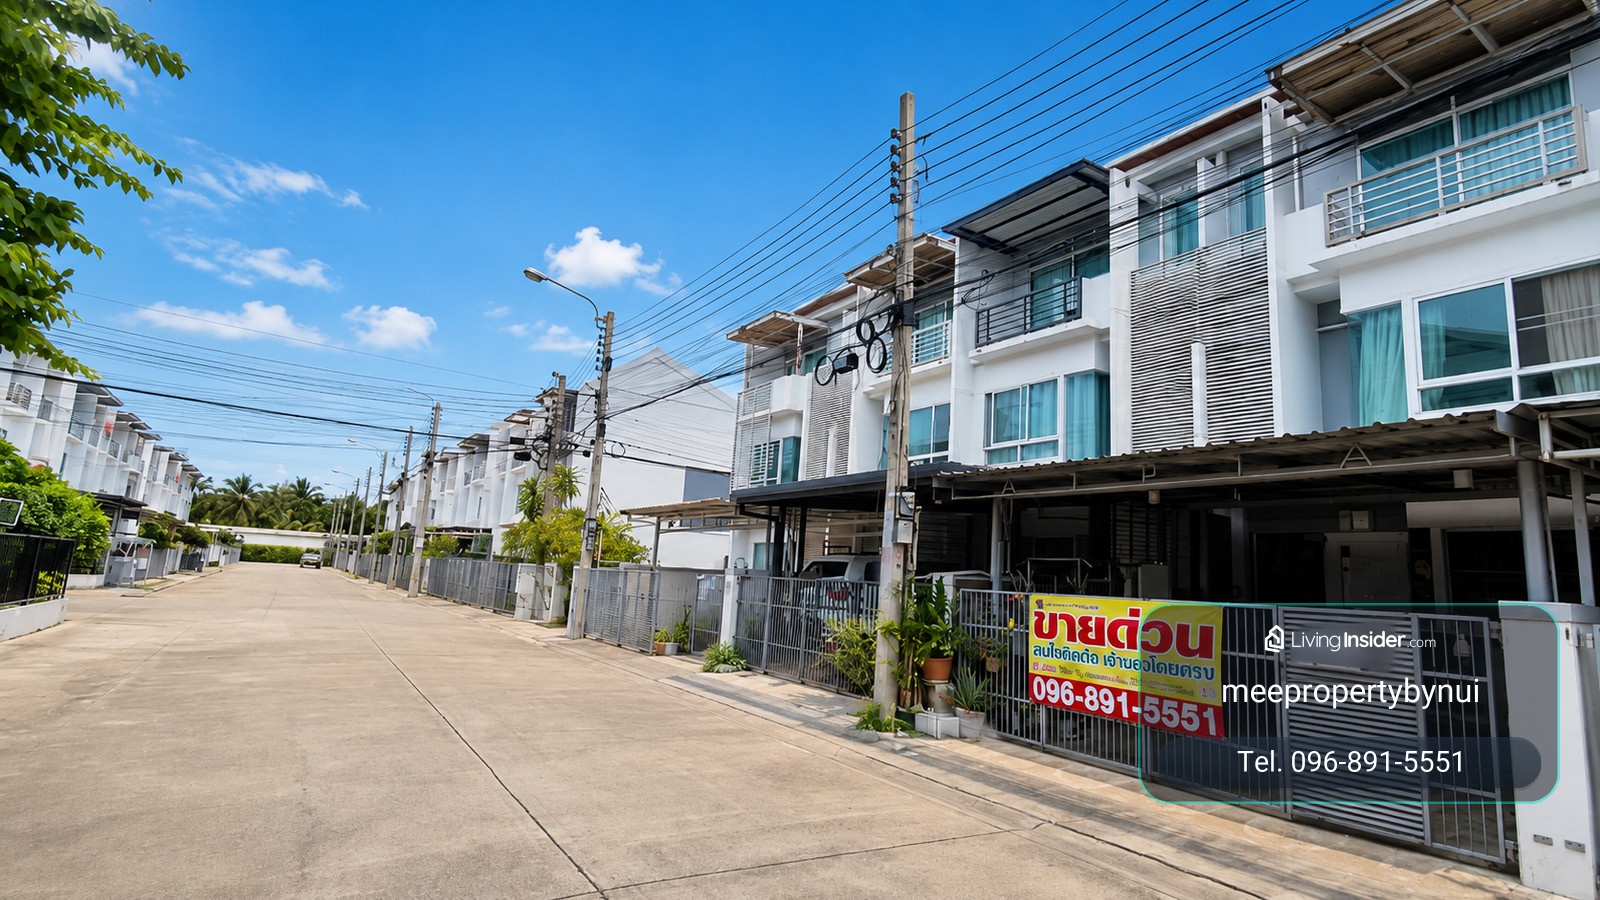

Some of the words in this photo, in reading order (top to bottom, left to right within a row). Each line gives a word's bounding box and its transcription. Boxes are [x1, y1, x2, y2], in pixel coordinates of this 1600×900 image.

[1032, 607, 1215, 660] ขายด่วน
[1032, 676, 1217, 737] 096-891-5551
